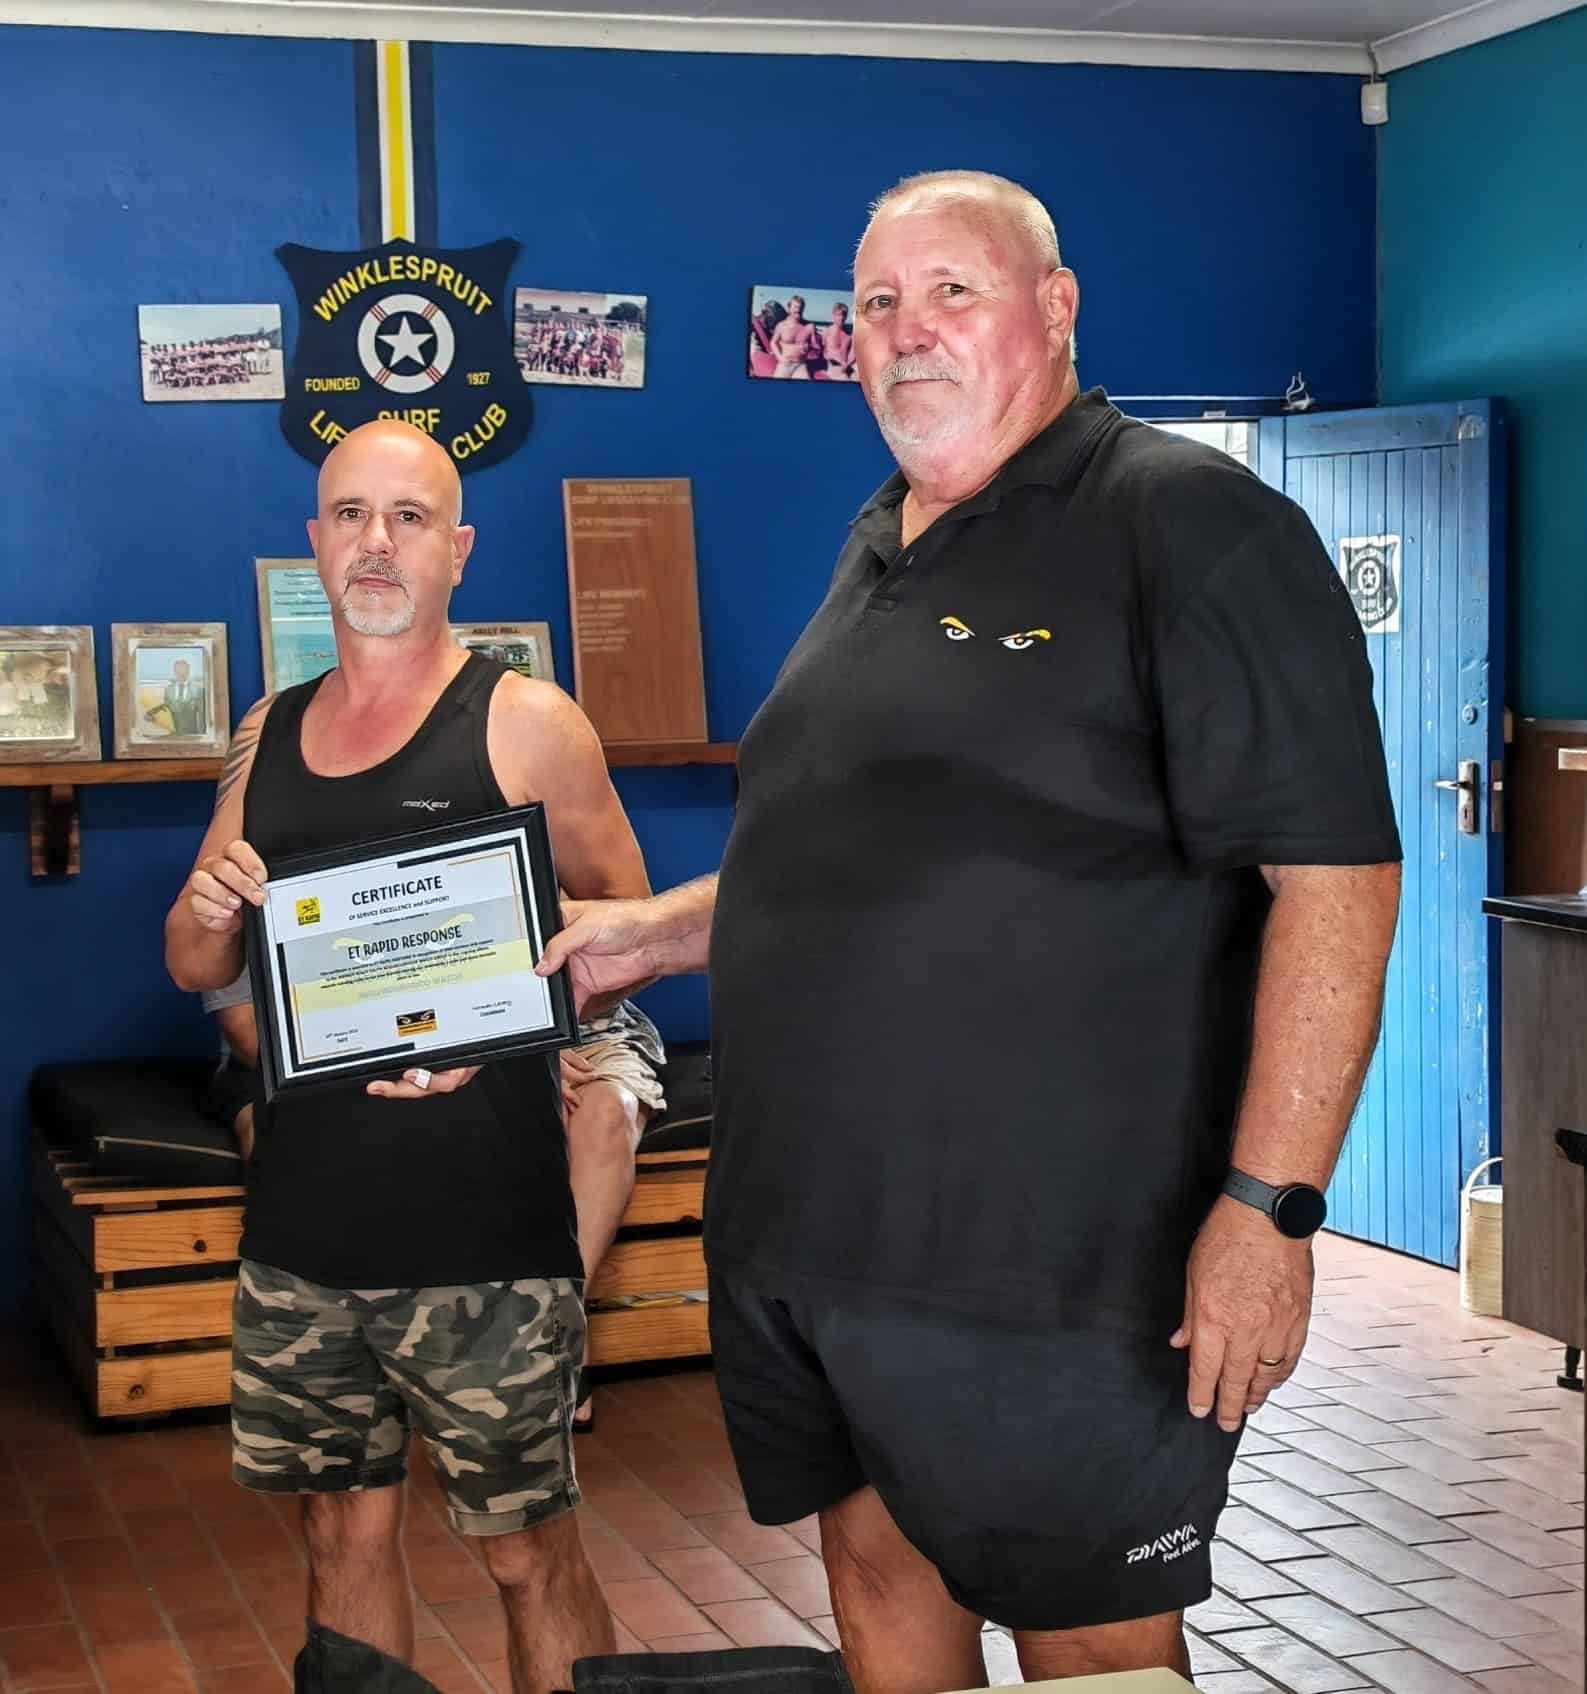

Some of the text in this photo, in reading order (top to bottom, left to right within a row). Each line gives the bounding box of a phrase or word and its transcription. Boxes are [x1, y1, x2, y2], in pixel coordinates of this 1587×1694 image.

[313, 255, 493, 321] WINKLESPRUIT
[304, 372, 491, 392] FOUNDED 1927
[451, 403, 508, 459] CLUB
[351, 875, 443, 906] CERTIFICATE
[348, 924, 463, 960] ET RAPID RESPONSE
[1125, 1522, 1198, 1564] DAIWA
